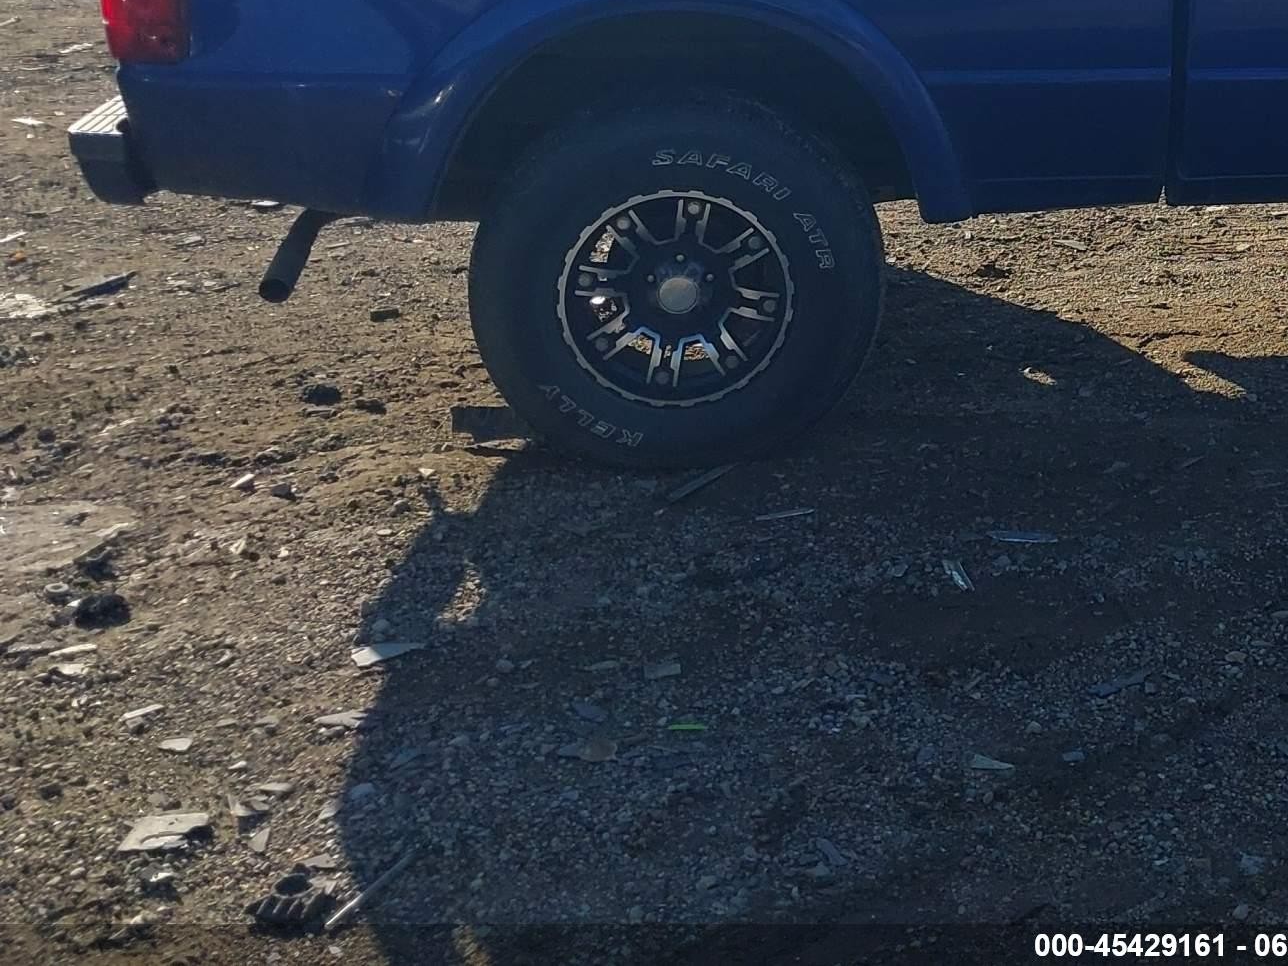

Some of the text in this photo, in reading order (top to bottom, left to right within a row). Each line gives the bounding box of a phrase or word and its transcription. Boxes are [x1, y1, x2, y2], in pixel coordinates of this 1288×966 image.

[651, 148, 836, 269] SAFARI ATR
[535, 384, 644, 447] KELLY
